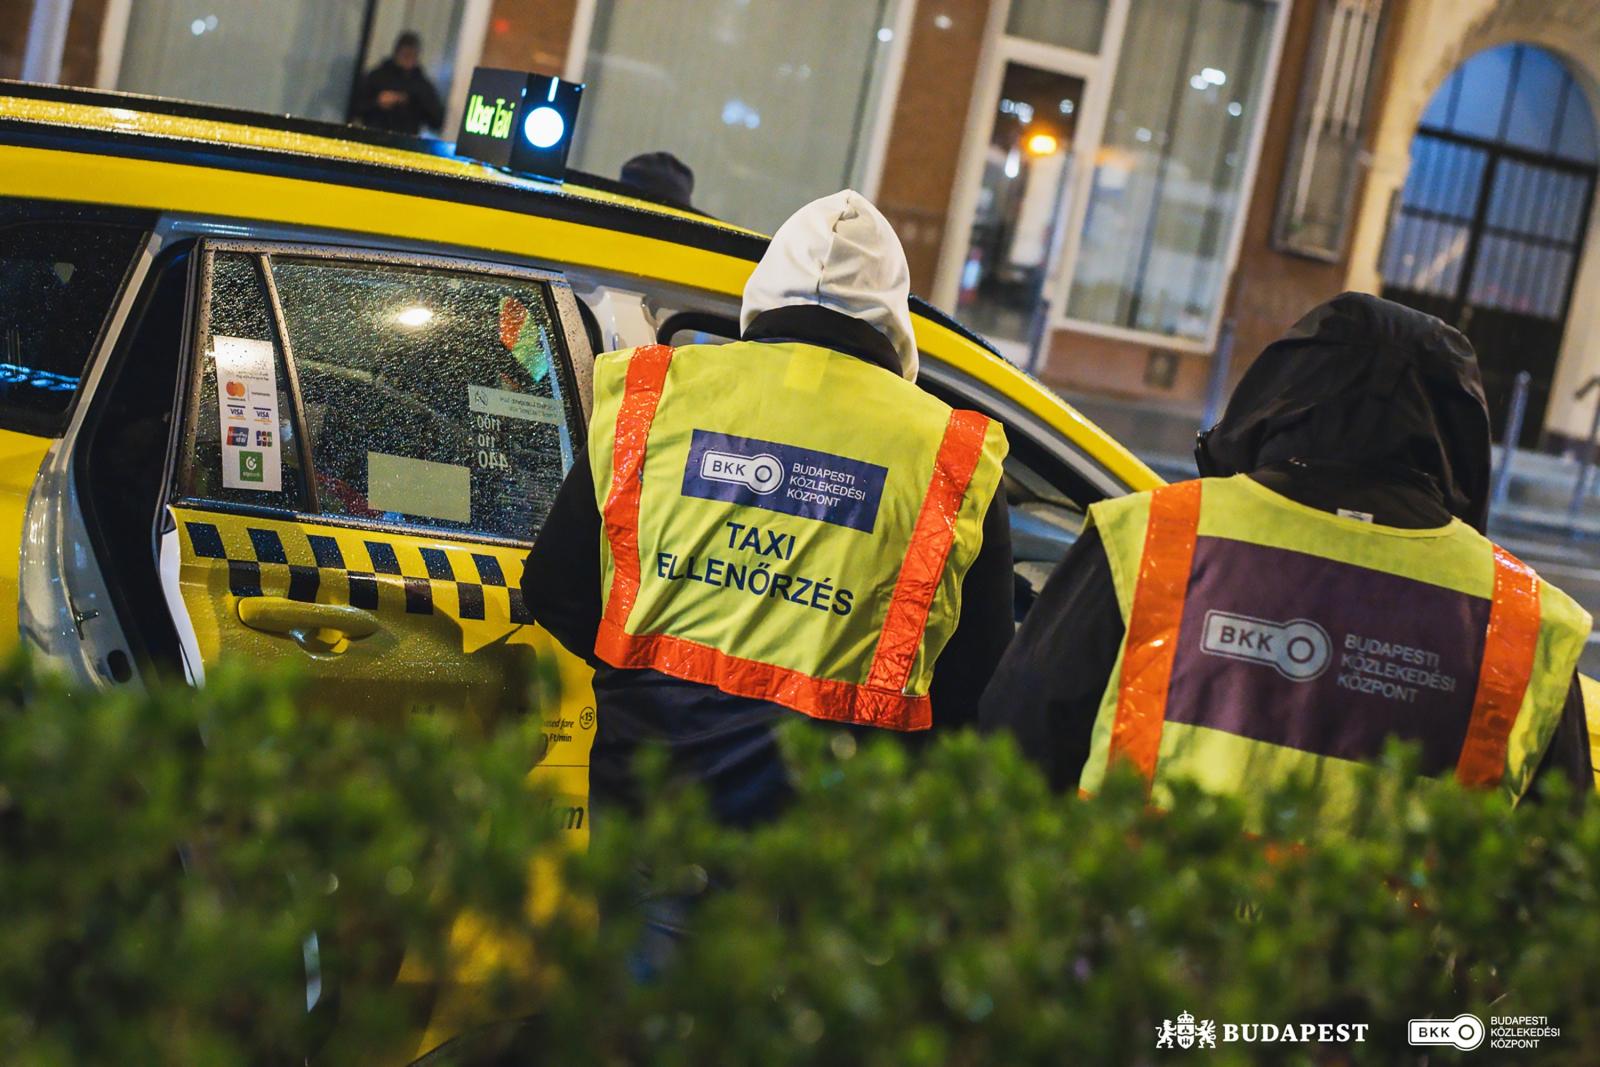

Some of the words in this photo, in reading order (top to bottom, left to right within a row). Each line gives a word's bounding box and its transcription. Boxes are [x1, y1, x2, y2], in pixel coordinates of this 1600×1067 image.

[465, 94, 496, 135] Uber
[491, 98, 515, 139] Taxi
[230, 408, 244, 416] VISA
[256, 410, 270, 418] VISA
[711, 459, 747, 477] BKK
[792, 462, 856, 485] BUDAPESTI
[786, 487, 841, 508] KÖZPONT
[789, 475, 867, 501] KÖZLEKEDÉSI
[726, 520, 797, 561] TAXI
[656, 551, 855, 616] ELLENŐRZÉS
[1219, 624, 1275, 653] BKK
[1343, 633, 1441, 669] BUDAPESTI
[1340, 652, 1457, 693] KÖZLEKEDÉSI
[1336, 672, 1419, 704] KÖZPONT
